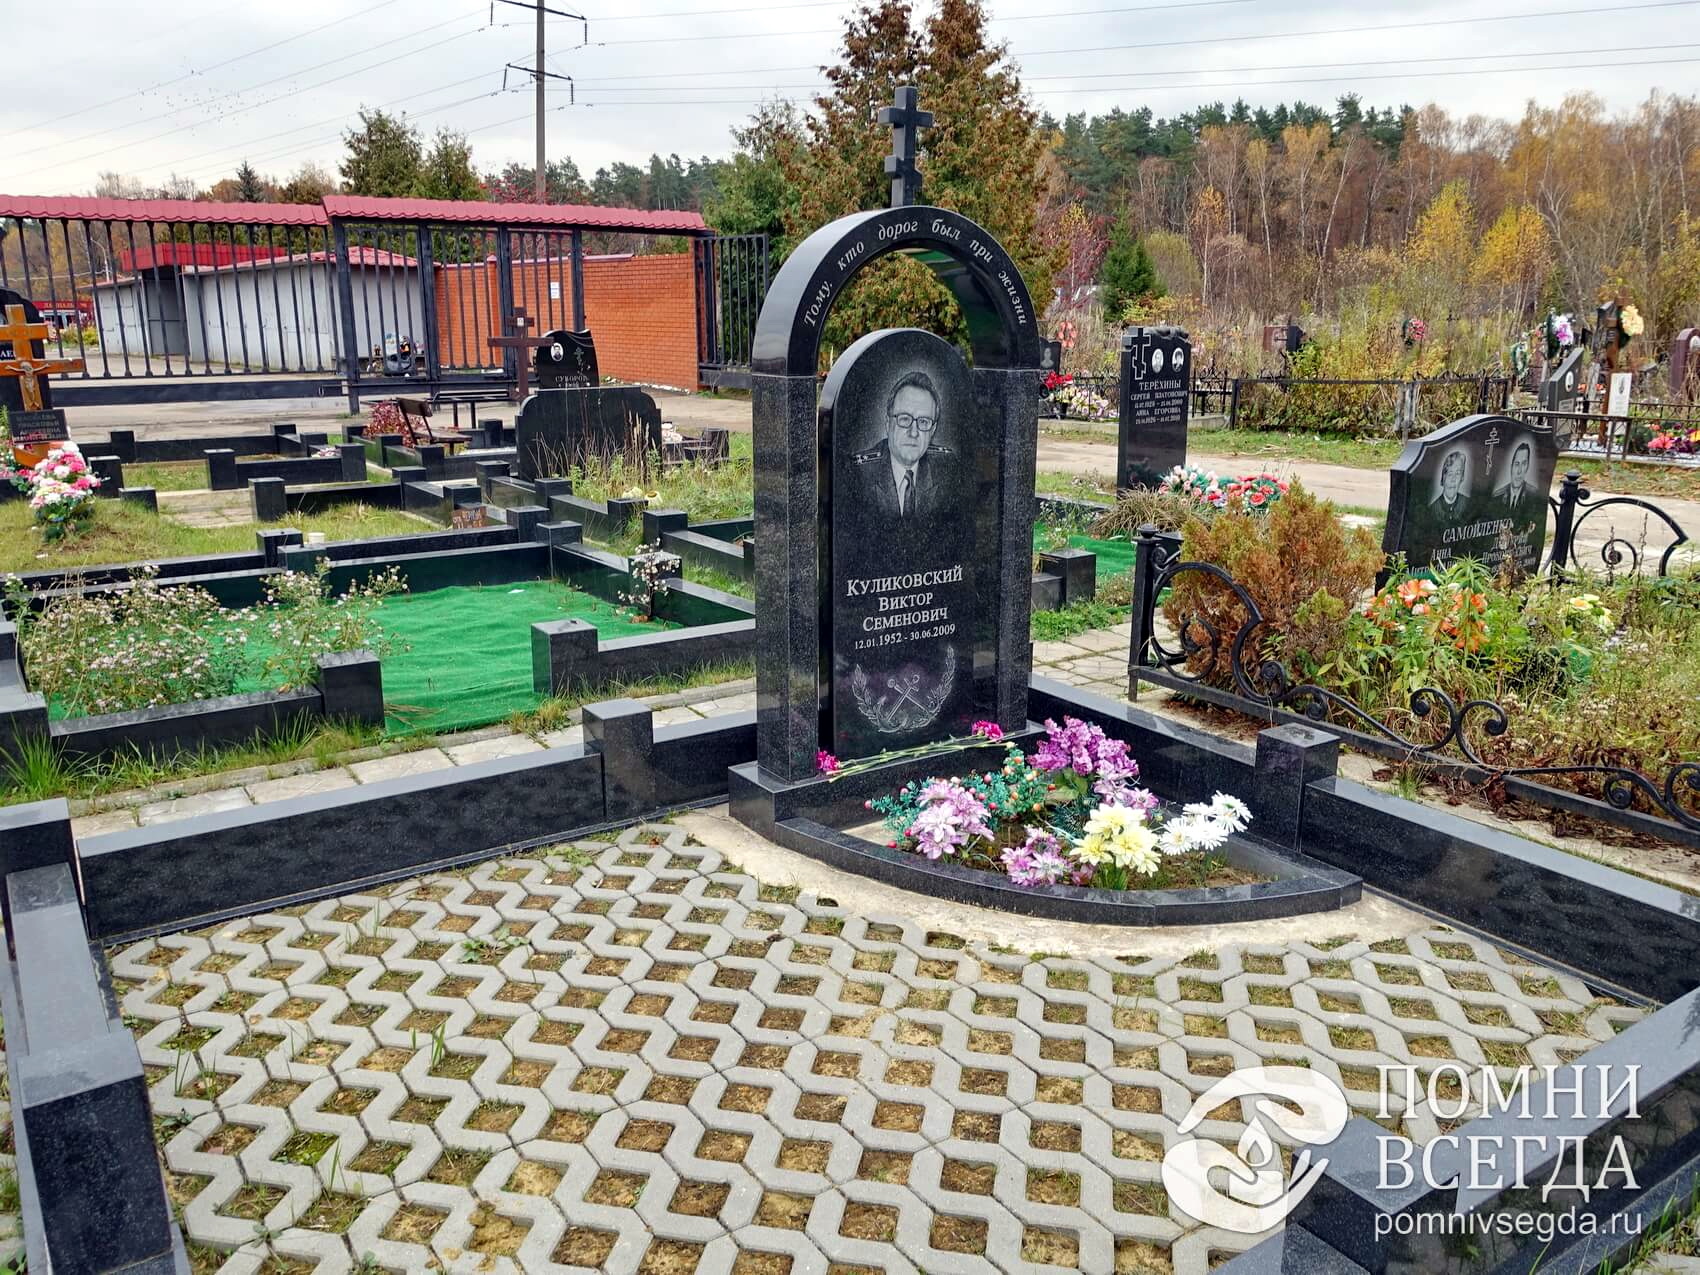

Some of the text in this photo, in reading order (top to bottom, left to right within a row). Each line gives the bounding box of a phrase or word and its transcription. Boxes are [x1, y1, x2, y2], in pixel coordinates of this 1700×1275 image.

[838, 241, 864, 271] кто
[878, 220, 918, 241] дорог
[932, 219, 960, 240] был
[969, 240, 993, 263] при
[998, 270, 1027, 324] жизни
[854, 632, 902, 650] 12.01.1952
[910, 623, 956, 641] 30.06.2009
